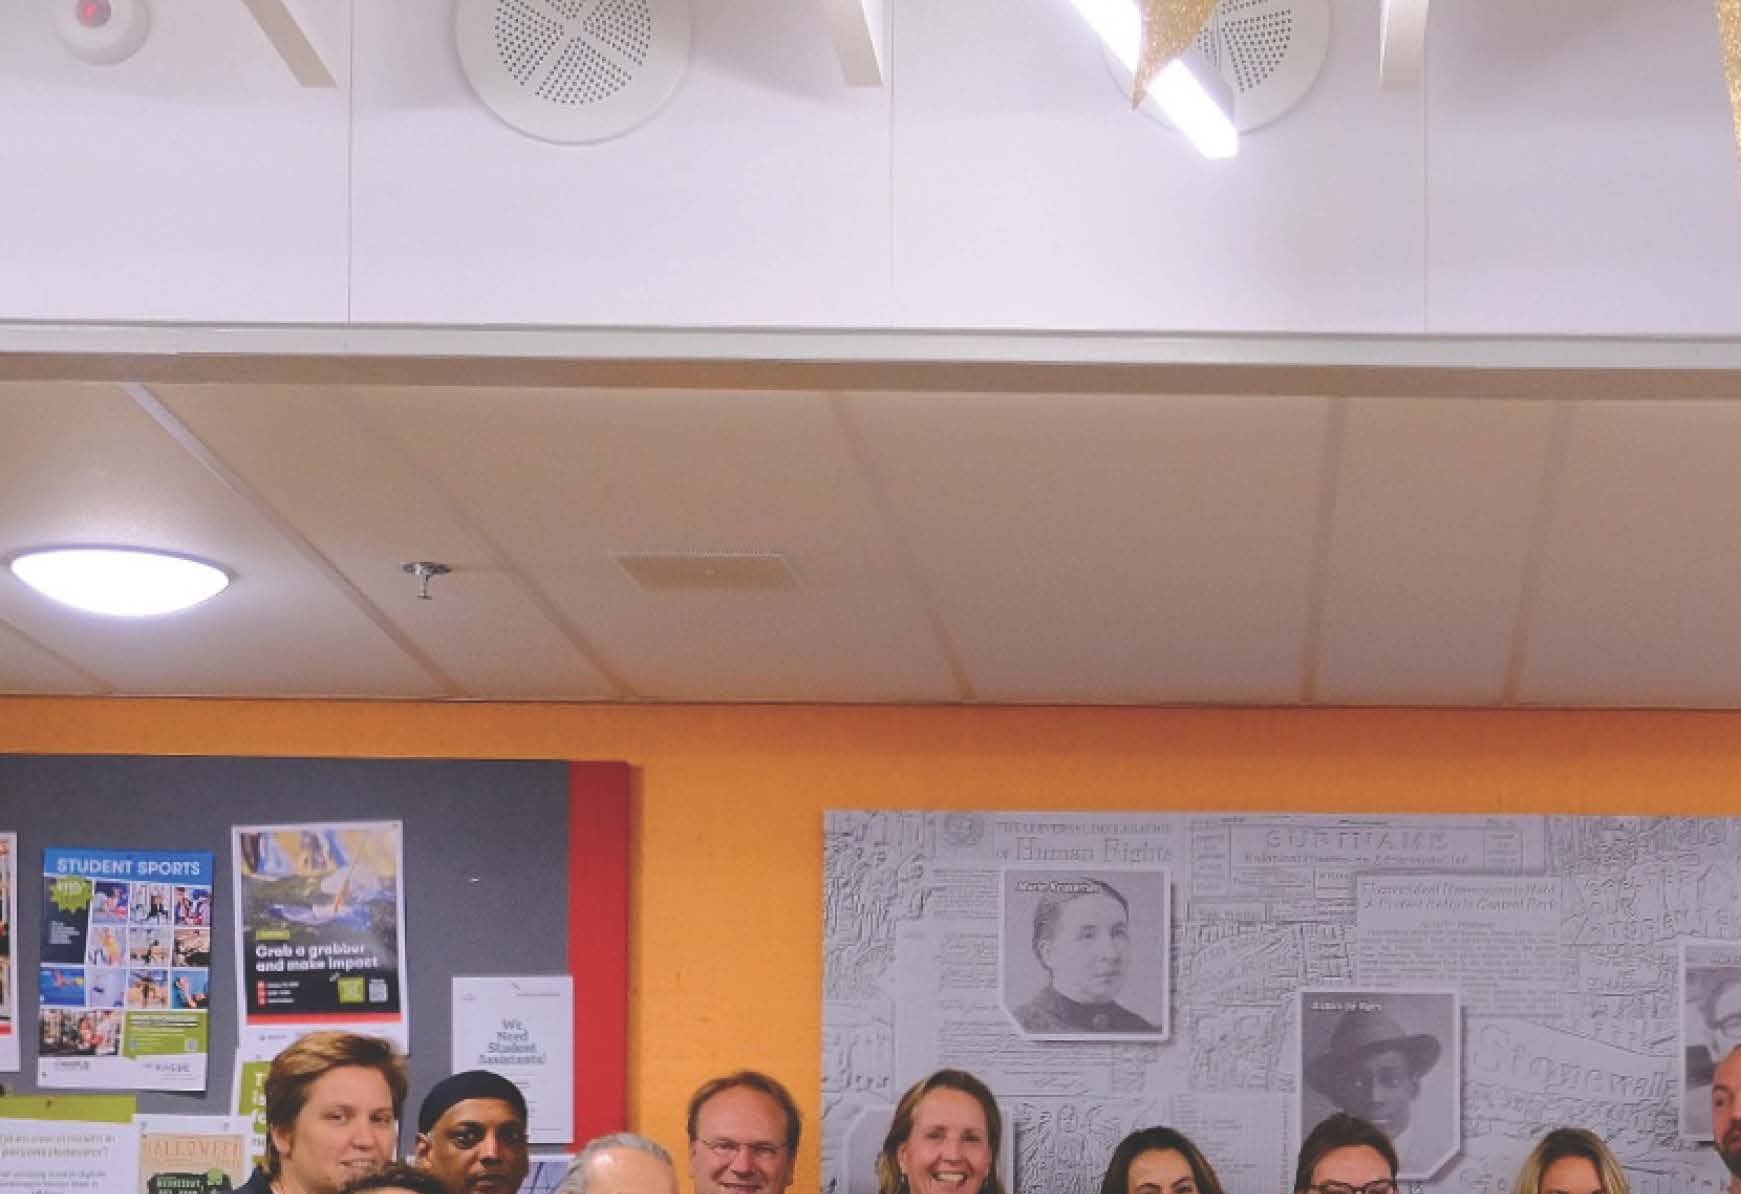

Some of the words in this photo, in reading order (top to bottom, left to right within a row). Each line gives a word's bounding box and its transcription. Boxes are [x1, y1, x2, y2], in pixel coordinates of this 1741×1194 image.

[1015, 836, 1094, 862] Human
[57, 857, 133, 874] STUDENT
[138, 860, 201, 876] SPORTS
[256, 943, 293, 958] Grab
[295, 946, 305, 957] a
[308, 943, 365, 959] grabber
[256, 959, 285, 972] and
[287, 959, 326, 972] make
